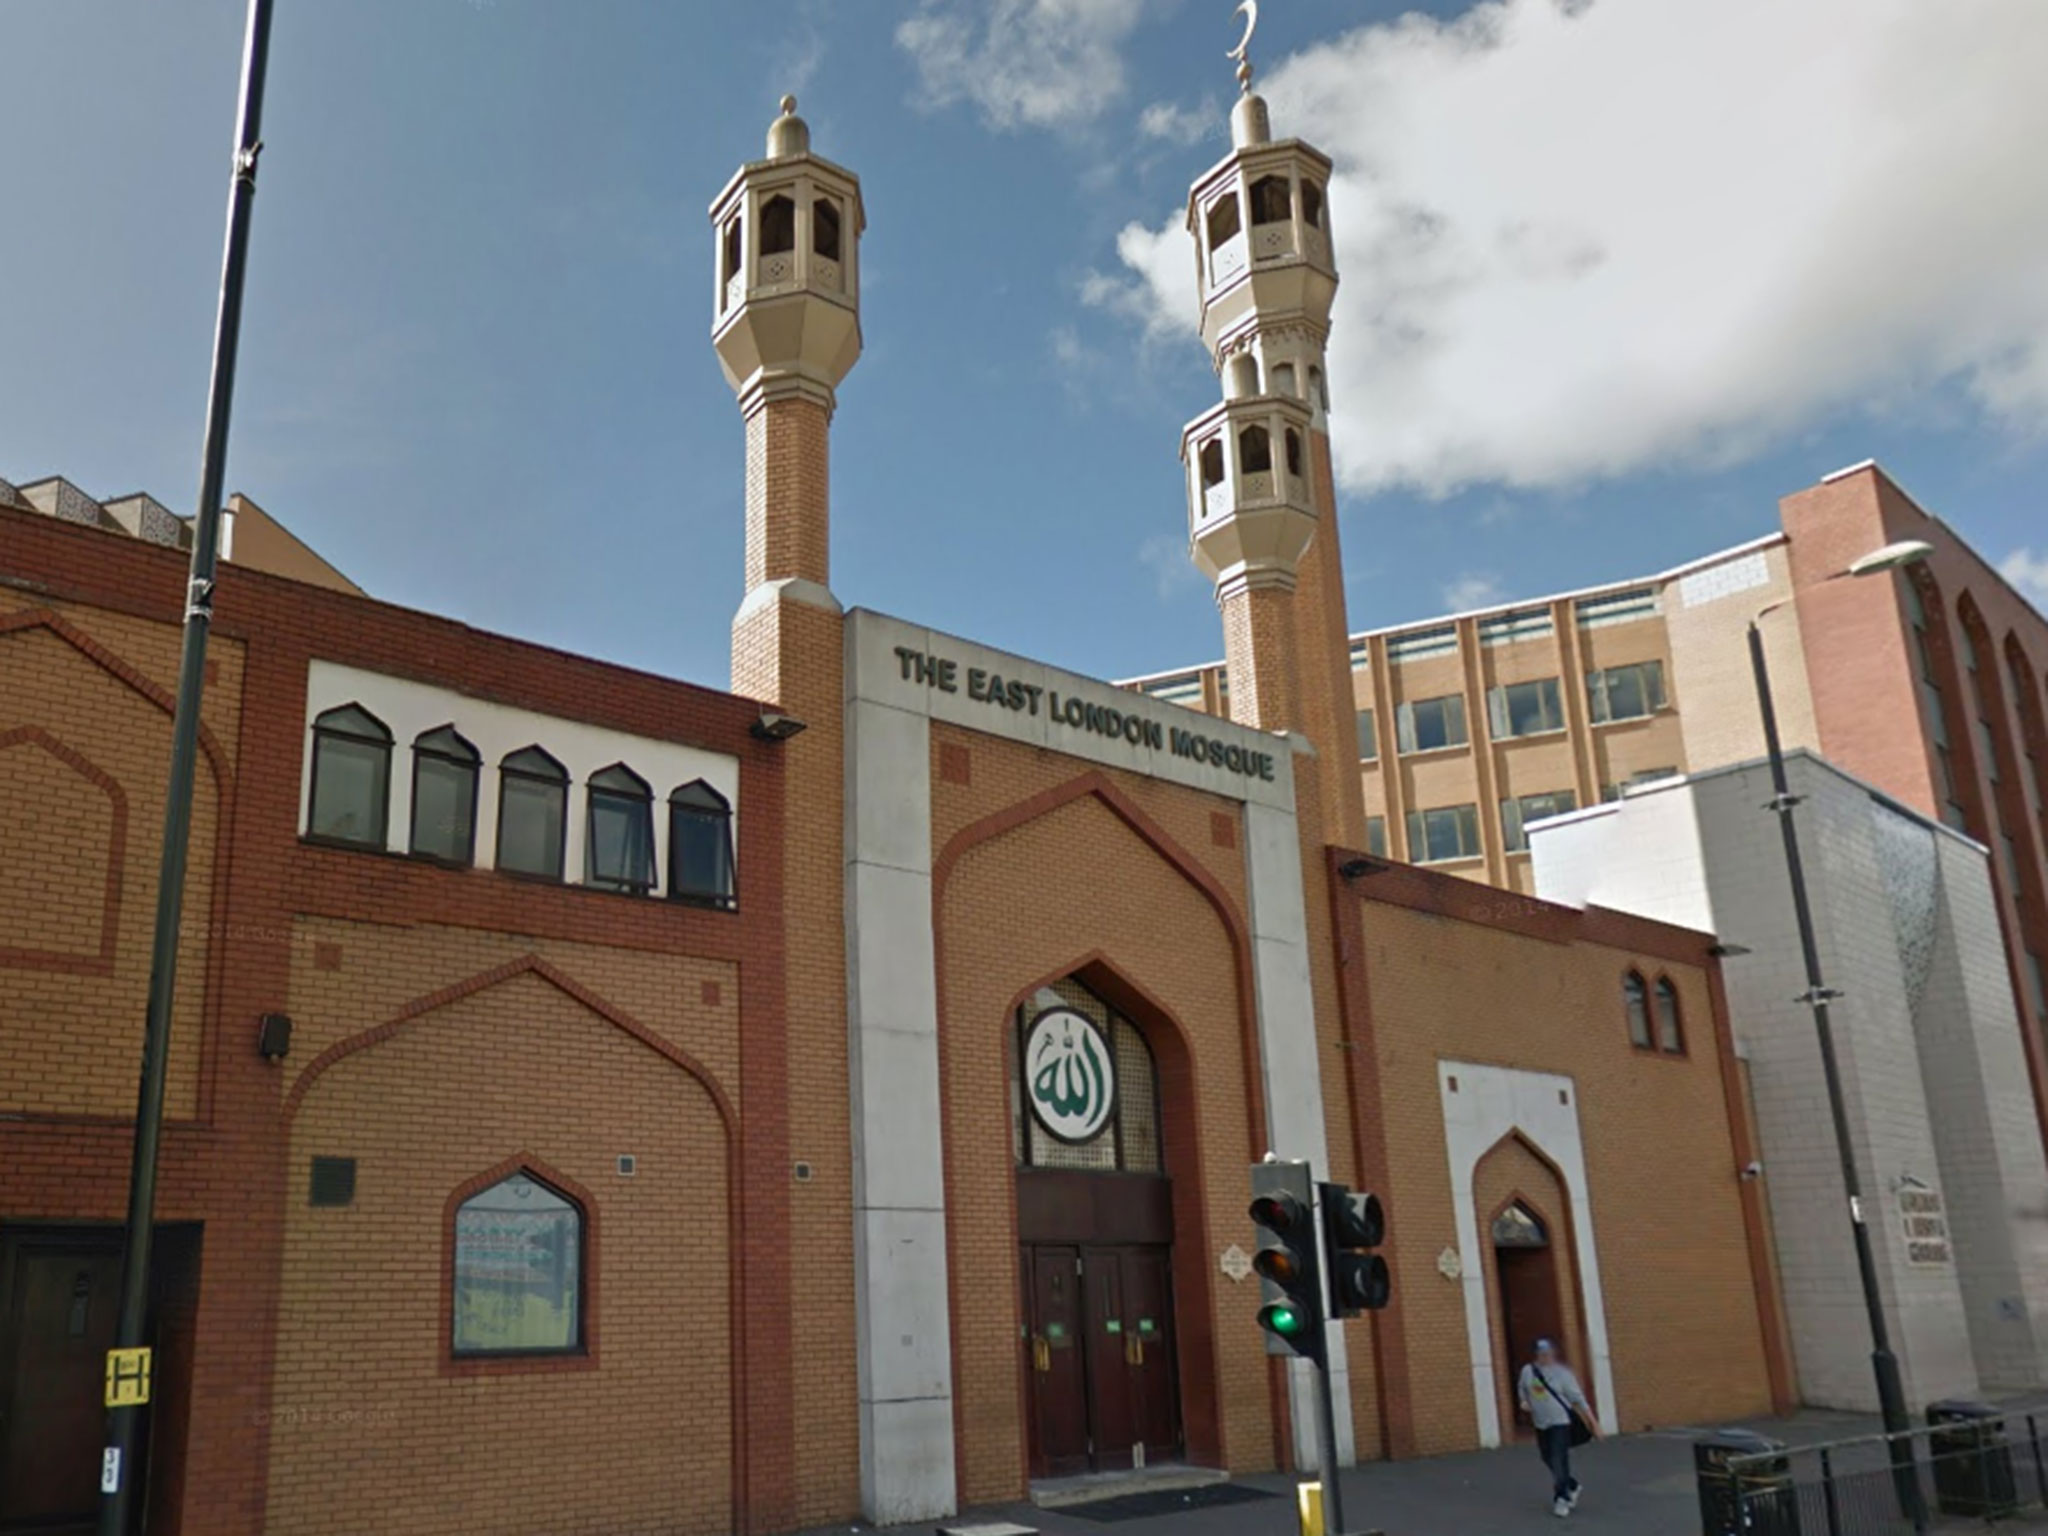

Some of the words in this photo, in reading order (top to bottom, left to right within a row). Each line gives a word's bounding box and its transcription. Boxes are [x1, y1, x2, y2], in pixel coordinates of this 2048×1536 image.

[894, 646, 958, 693] THE
[968, 668, 1043, 717] EAST
[1050, 692, 1162, 750] LONDON
[1171, 727, 1275, 781] MOSQUE
[113, 1354, 144, 1400] H
